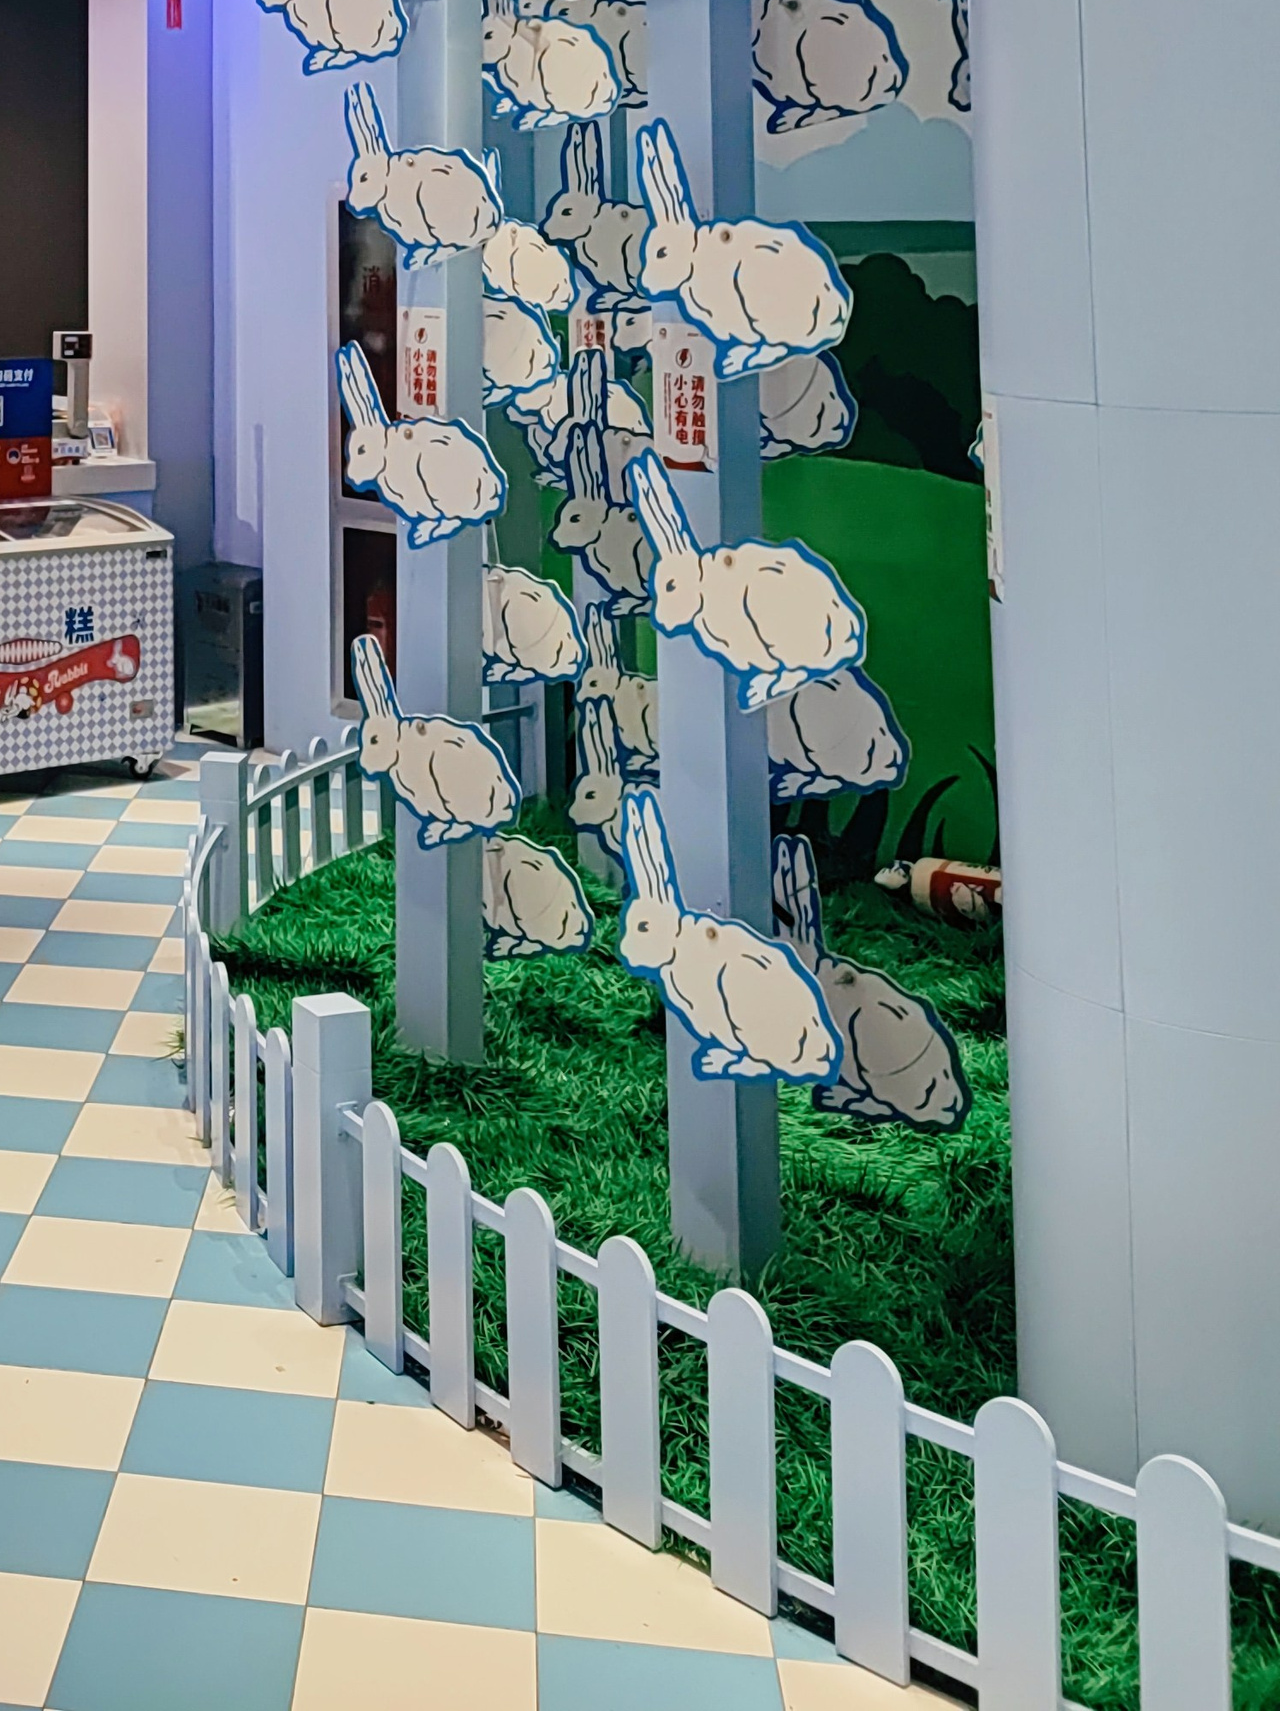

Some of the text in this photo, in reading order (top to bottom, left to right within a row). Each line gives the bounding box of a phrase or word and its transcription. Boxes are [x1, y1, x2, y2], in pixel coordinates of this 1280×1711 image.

[413, 348, 423, 405] 小心有电
[426, 350, 438, 406] 请勿触摸
[674, 374, 688, 445] 小心有电
[692, 375, 705, 445] 请勿触摸
[44, 663, 88, 693] Rabbit
